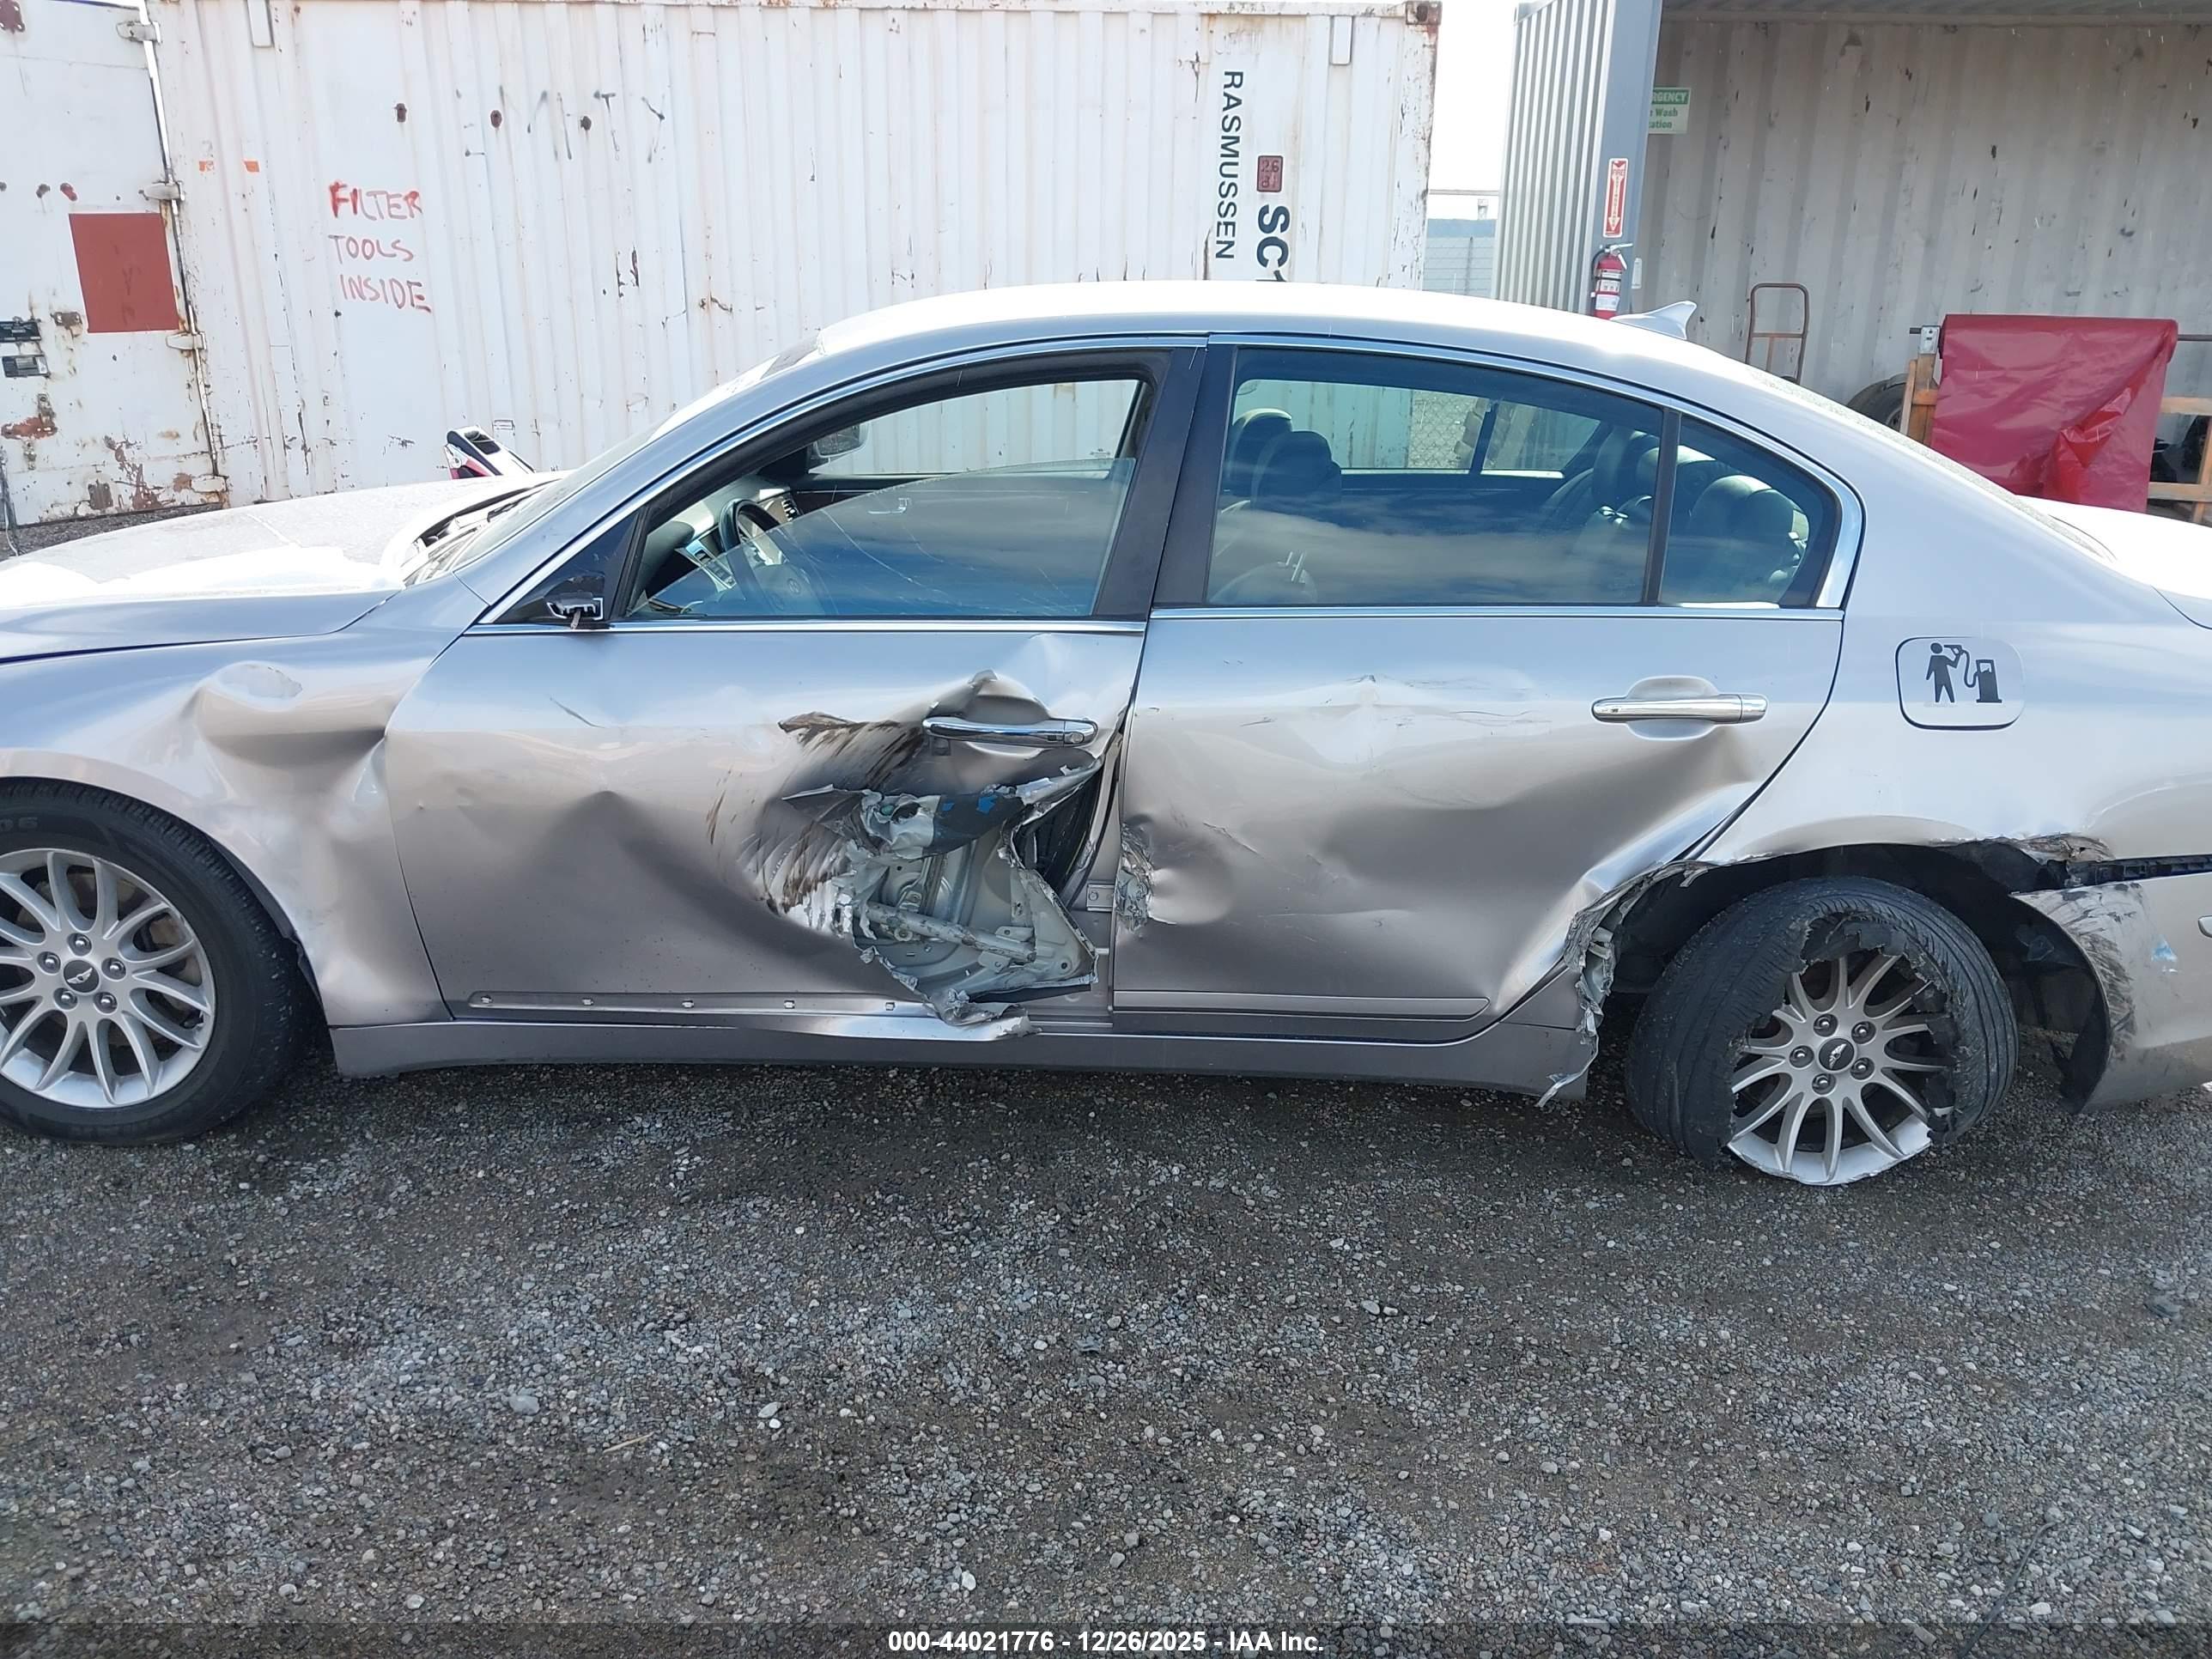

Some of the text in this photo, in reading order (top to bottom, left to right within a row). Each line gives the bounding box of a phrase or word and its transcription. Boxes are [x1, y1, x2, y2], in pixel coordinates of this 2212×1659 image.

[1649, 119, 1673, 129] ation
[1656, 107, 1678, 117] Wash
[1215, 70, 1244, 258] RASMUSSEN
[329, 180, 423, 222] FILTER
[327, 234, 414, 264] TOOLS
[340, 273, 432, 313] INSIDE
